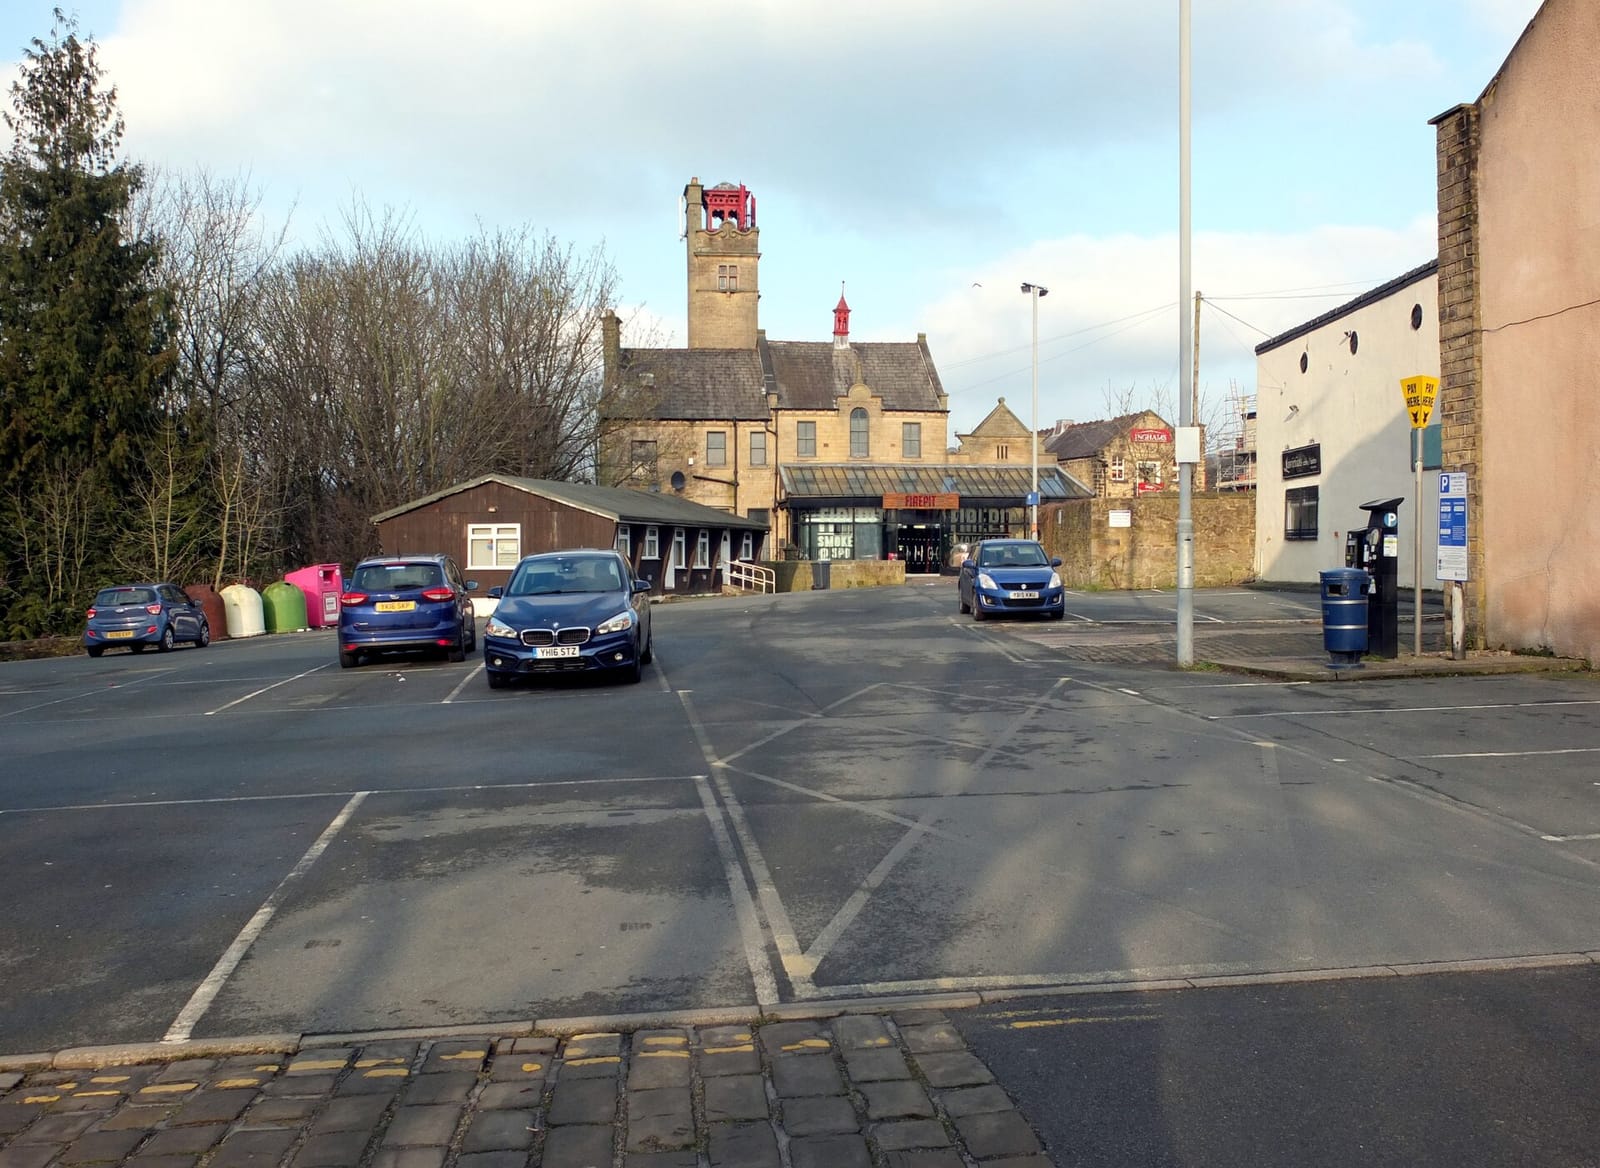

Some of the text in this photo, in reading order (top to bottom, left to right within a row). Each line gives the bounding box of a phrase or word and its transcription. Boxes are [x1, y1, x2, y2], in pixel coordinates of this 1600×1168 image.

[1407, 383, 1417, 395] PAY
[1425, 382, 1434, 394] PAY
[1406, 396, 1421, 408] HERE
[1422, 396, 1435, 408] HERE
[905, 495, 937, 508] FIREPIT
[817, 534, 854, 548] SMOKE
[540, 647, 577, 657] YH16 STZ
